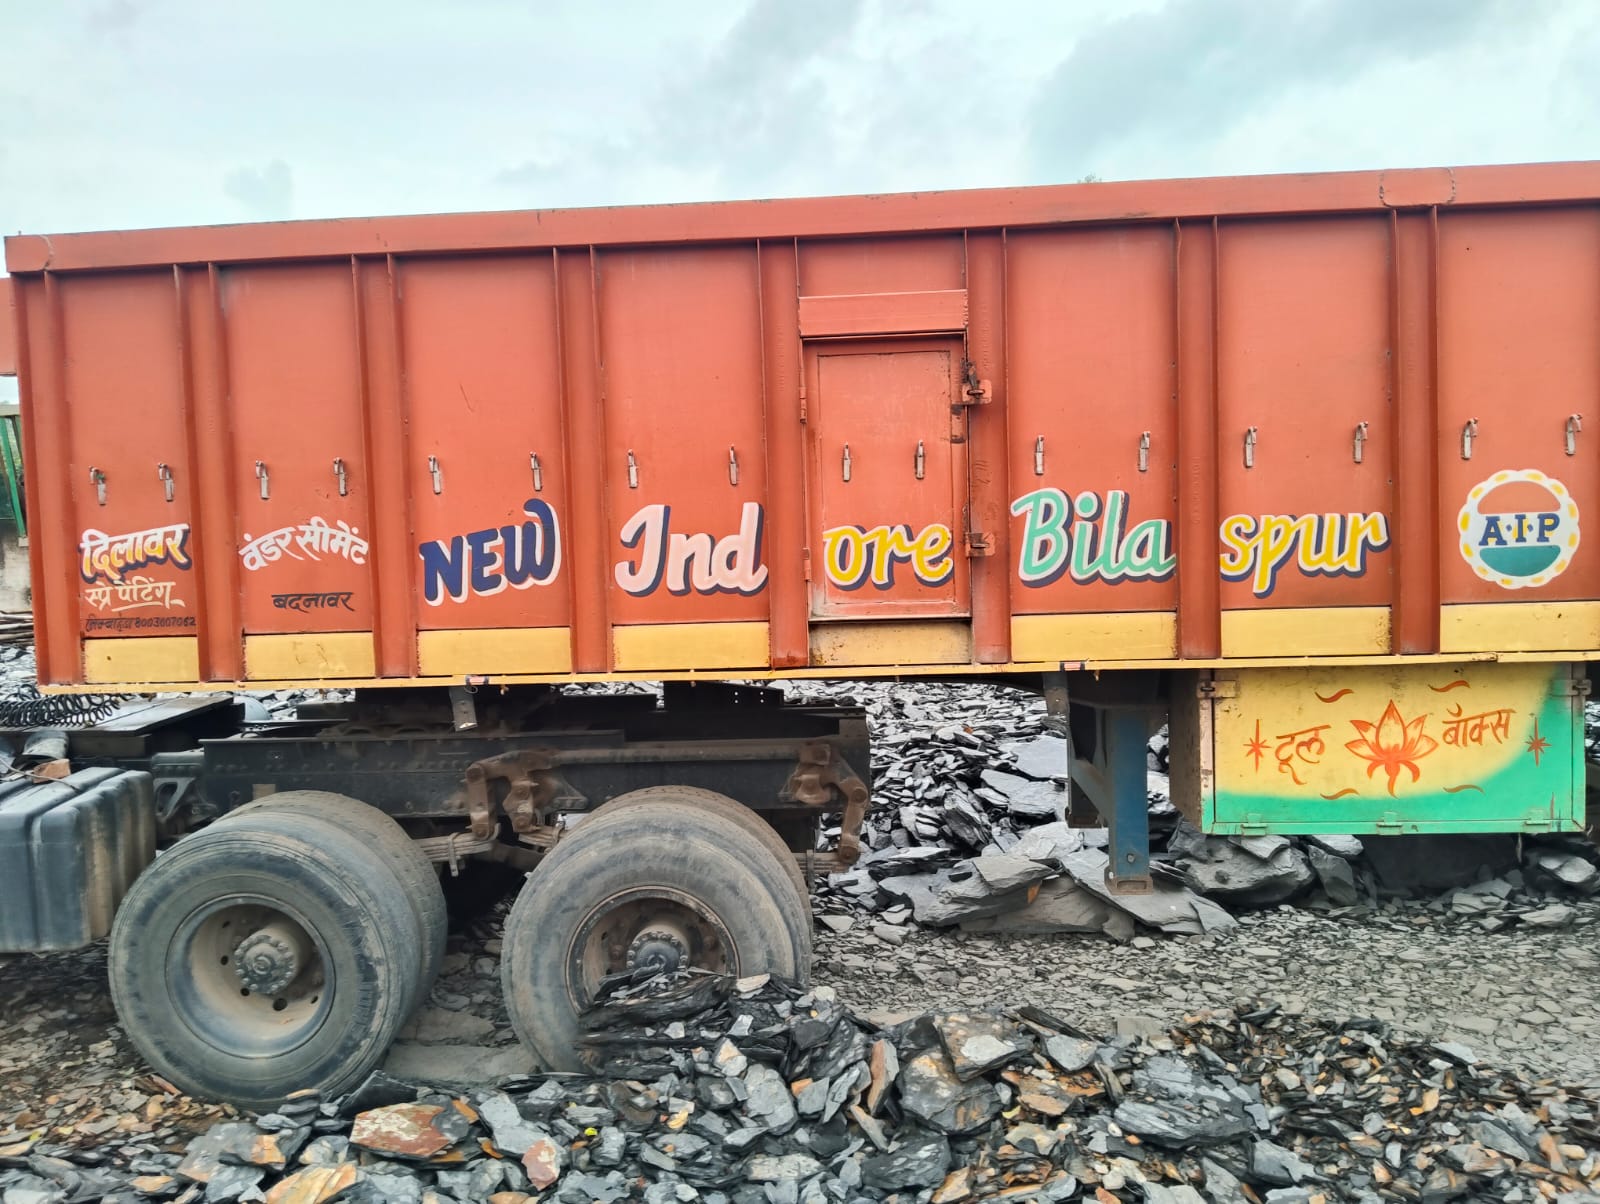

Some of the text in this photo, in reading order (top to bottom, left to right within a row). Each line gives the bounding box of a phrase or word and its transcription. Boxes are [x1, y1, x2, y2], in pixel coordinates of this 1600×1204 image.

[79, 523, 192, 585] दिलावर
[419, 487, 1391, 606] NEW Ind ore Bila spur
[271, 592, 356, 613] बदनावर
[1274, 702, 1516, 785] टूल बॉक्स
